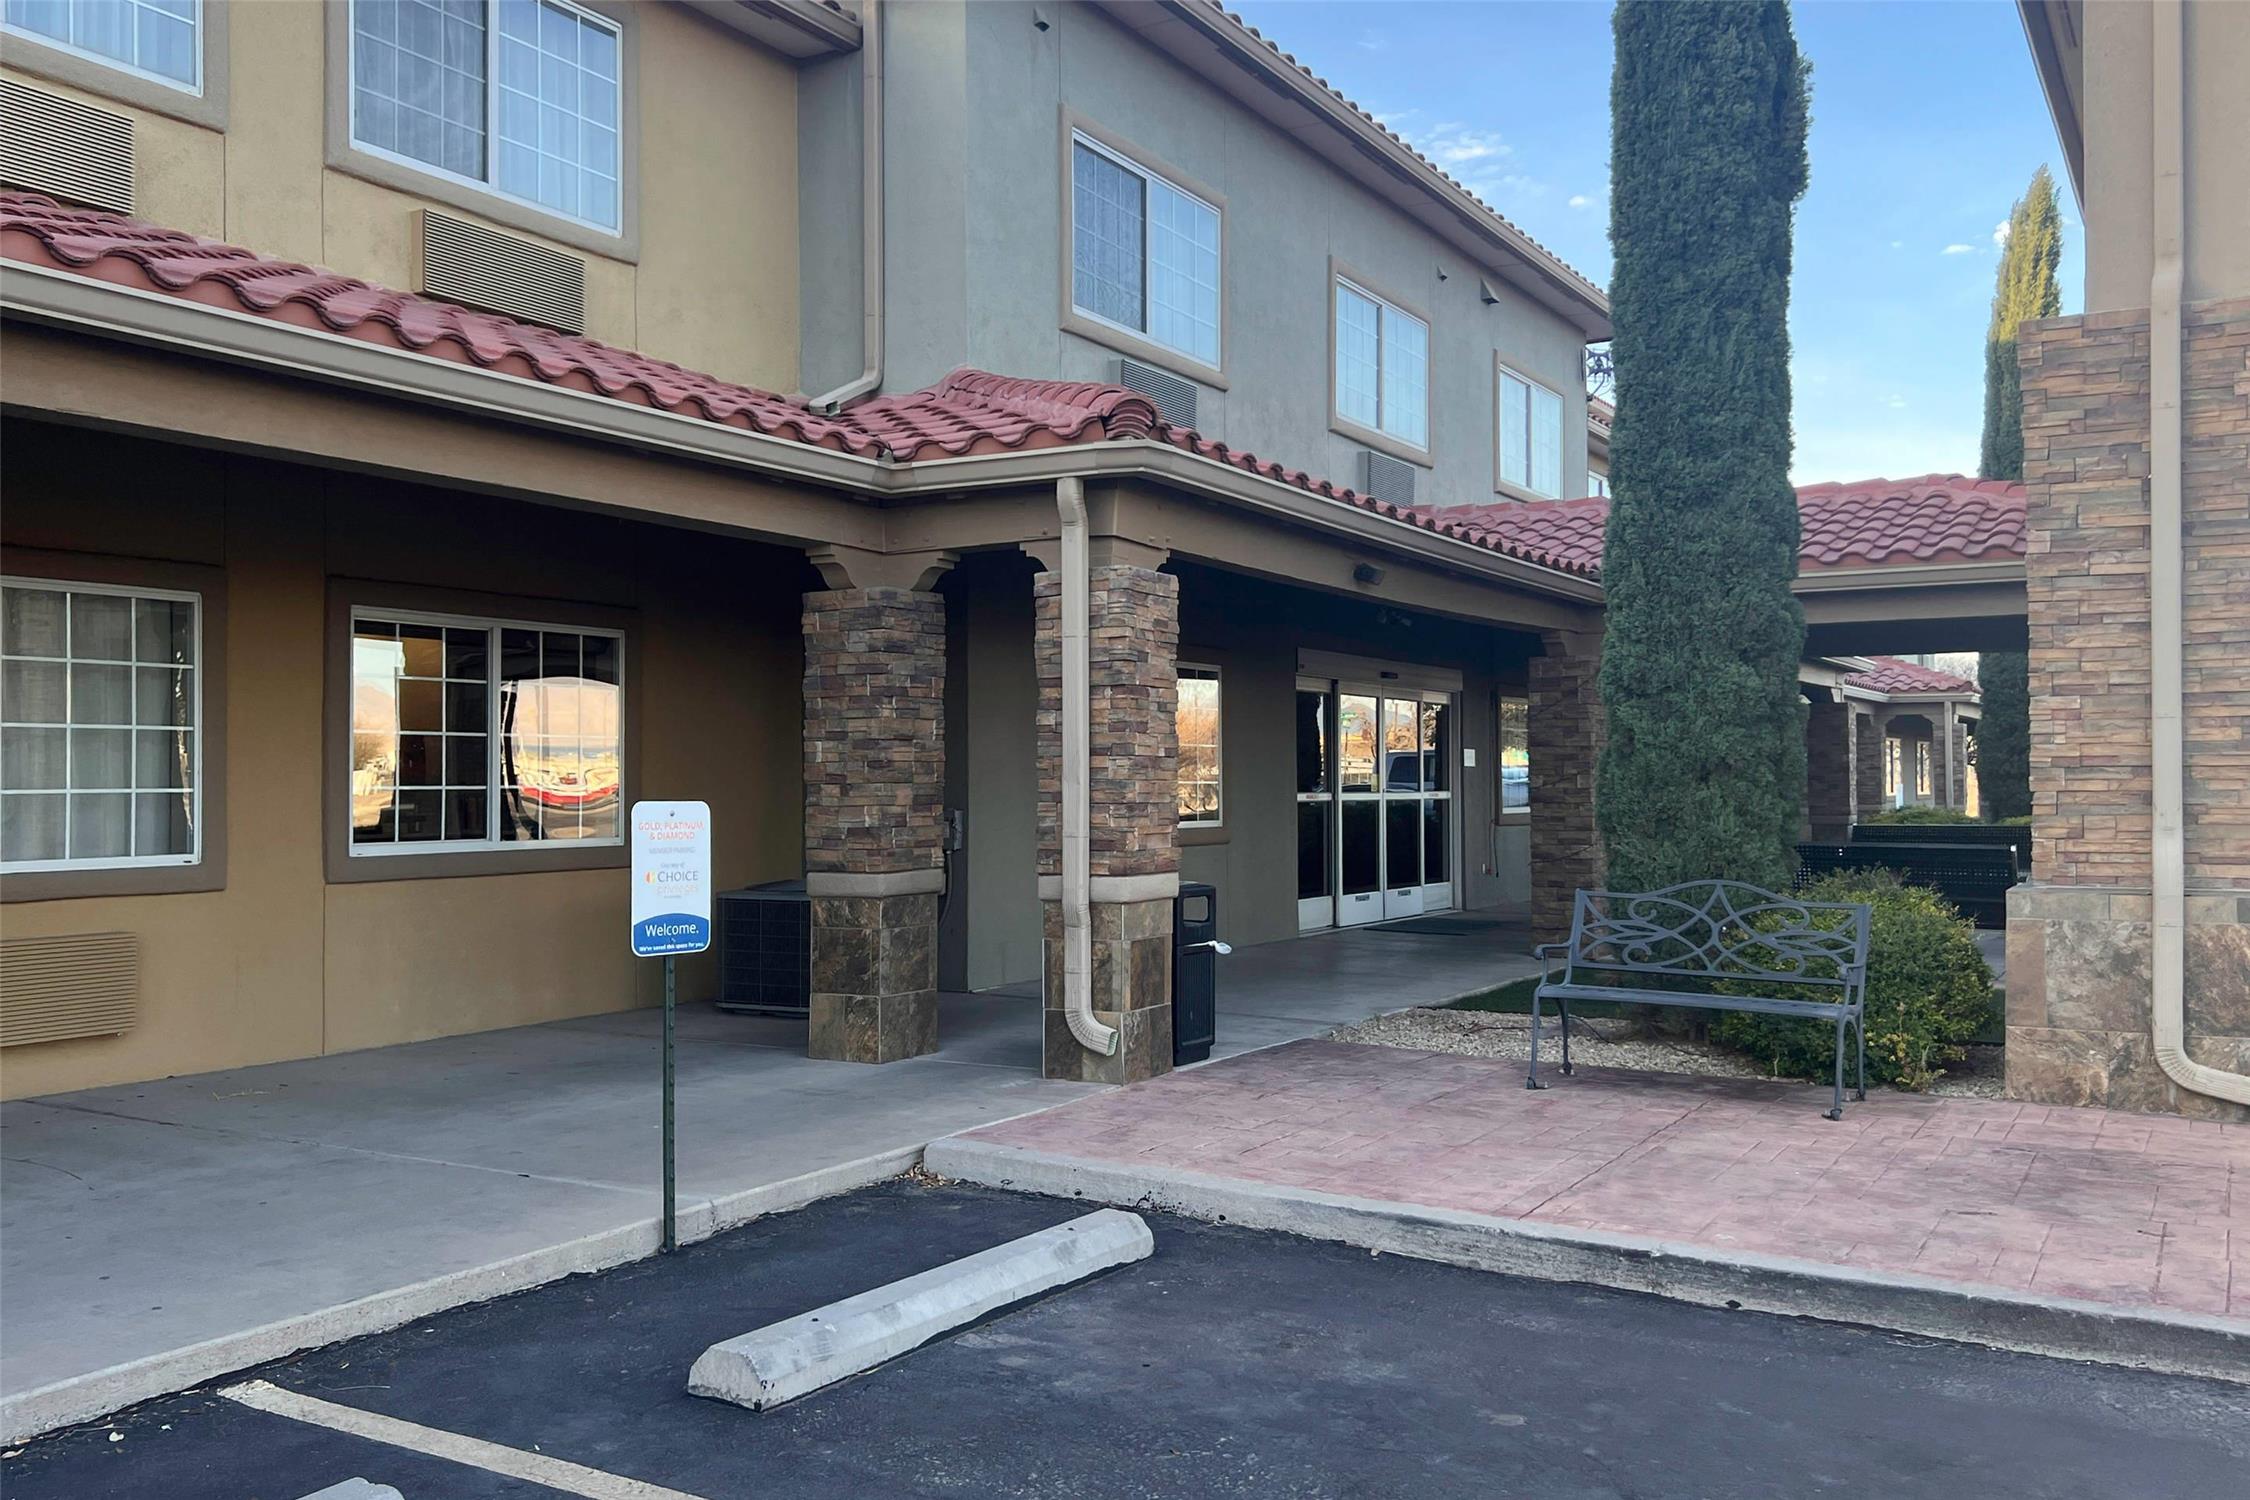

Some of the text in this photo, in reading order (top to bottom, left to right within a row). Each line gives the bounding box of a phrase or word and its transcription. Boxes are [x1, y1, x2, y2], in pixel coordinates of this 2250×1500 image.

[665, 821, 704, 831] PLATINUM
[650, 831, 695, 841] & DIAMOND
[657, 870, 699, 883] CHOICE
[646, 923, 700, 937] Welcome.
